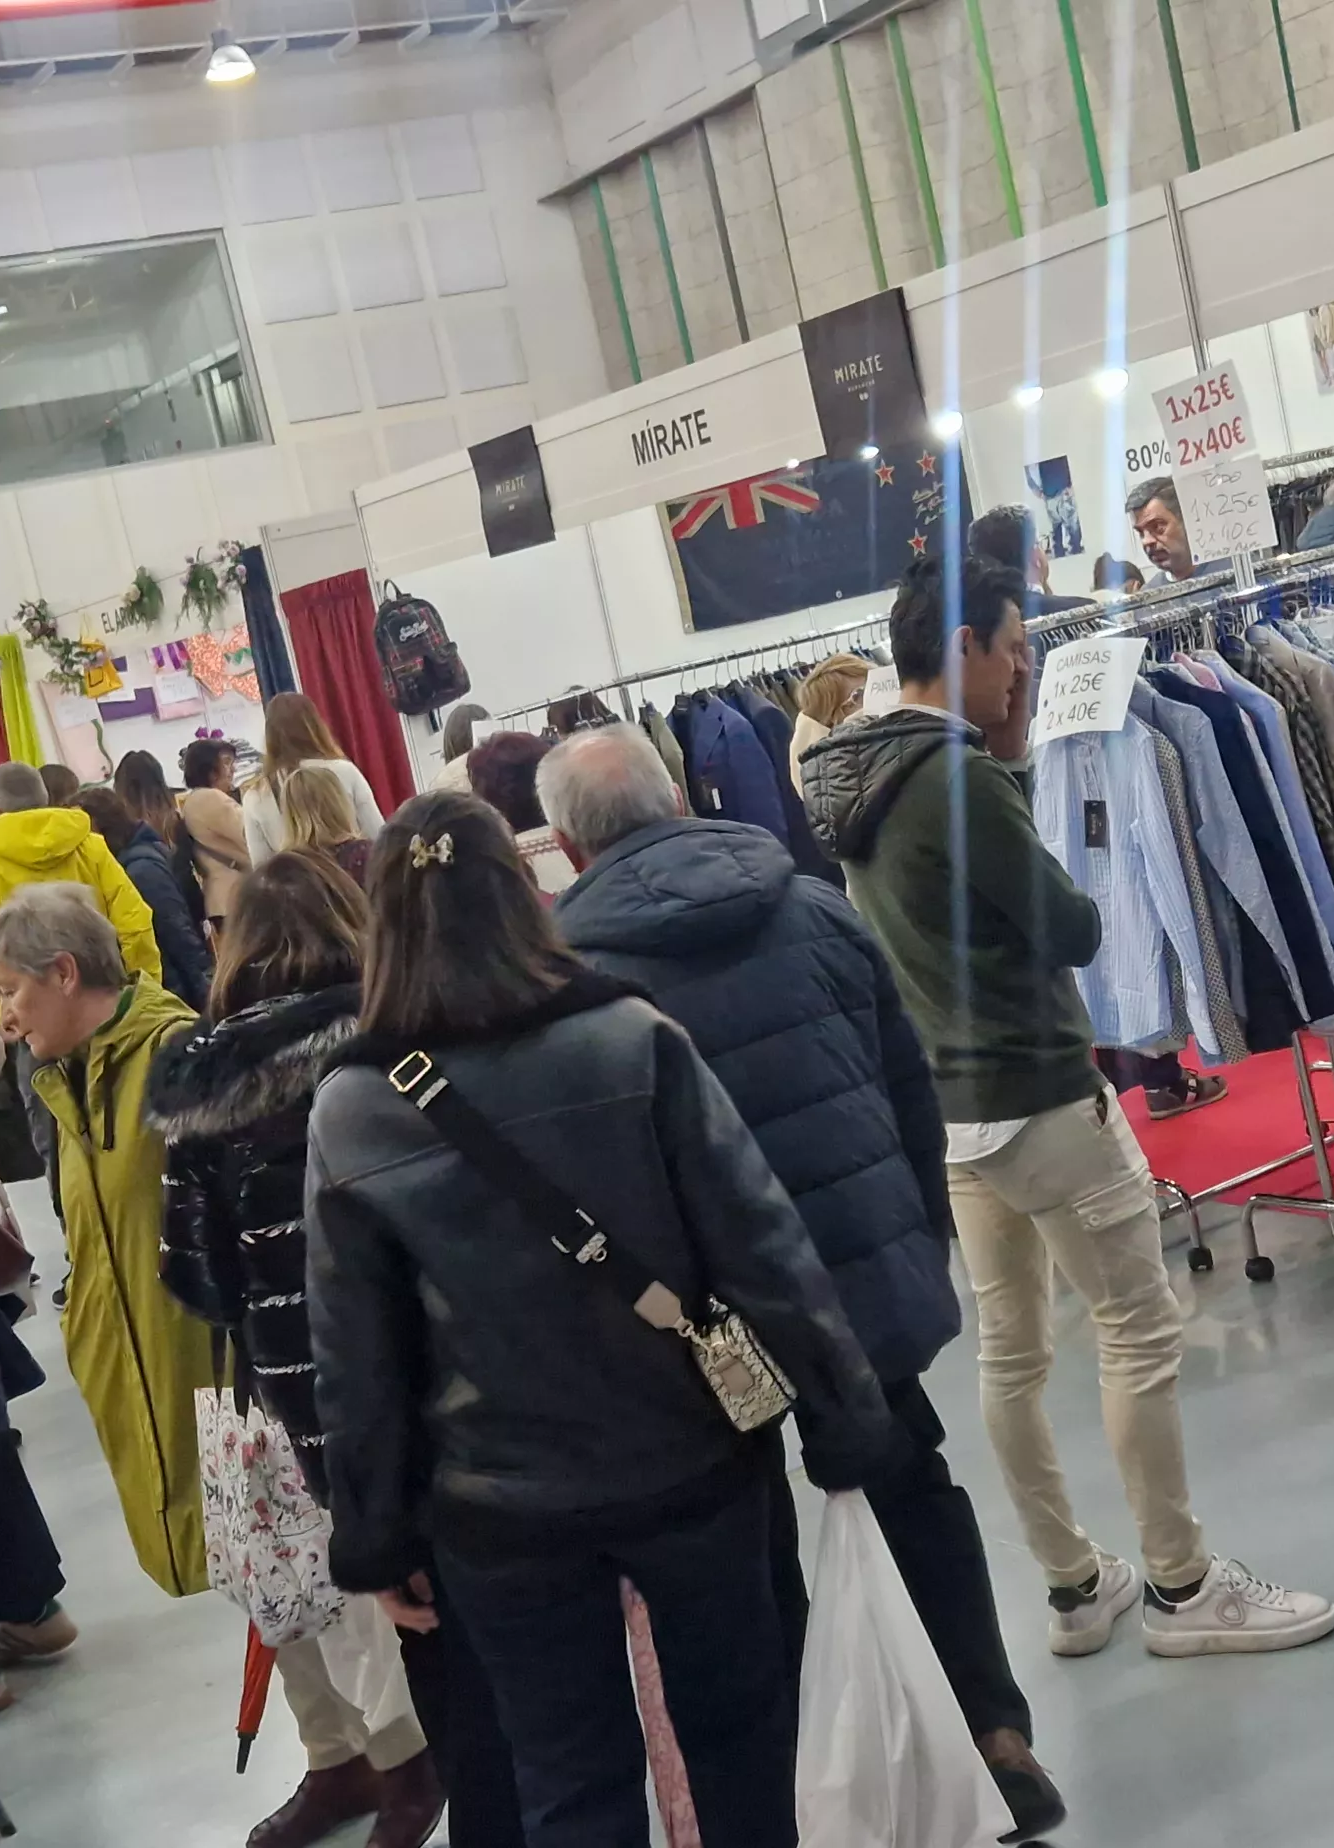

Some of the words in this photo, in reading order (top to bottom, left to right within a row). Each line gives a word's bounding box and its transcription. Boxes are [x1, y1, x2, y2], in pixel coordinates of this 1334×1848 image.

[834, 354, 884, 385] MIRATE
[1165, 373, 1235, 424] 1x25€
[631, 409, 712, 466] MÍRATE
[1177, 416, 1246, 466] 2x40€
[1126, 440, 1171, 472] 80%
[101, 611, 115, 634] EL
[1056, 650, 1111, 672] CAMISAS
